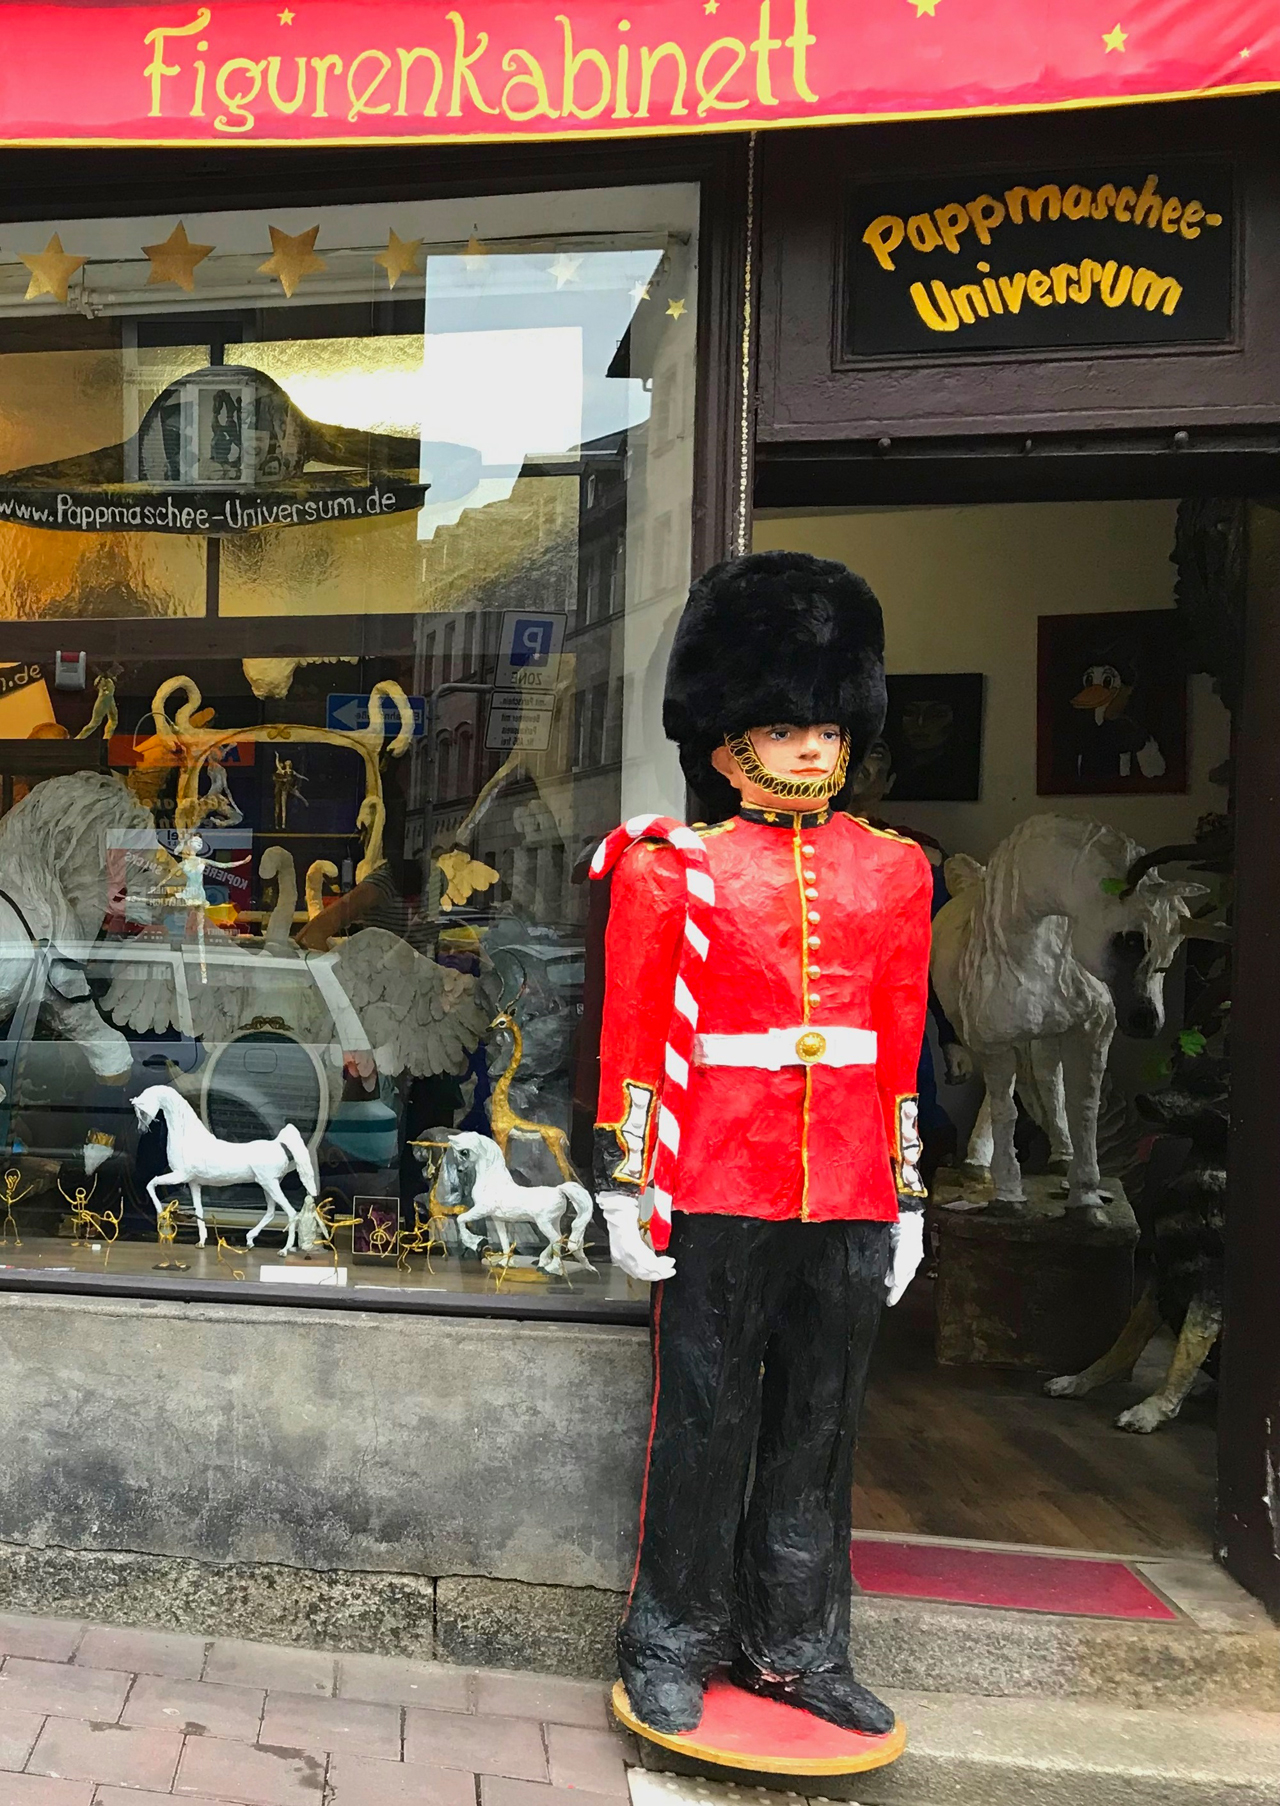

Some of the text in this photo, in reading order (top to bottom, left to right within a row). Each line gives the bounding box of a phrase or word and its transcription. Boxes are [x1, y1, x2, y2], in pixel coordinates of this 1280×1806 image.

[144, 0, 819, 132] Figurenkabinett
[862, 174, 1222, 271] Pappmaschee-
[910, 258, 1183, 332] Universum
